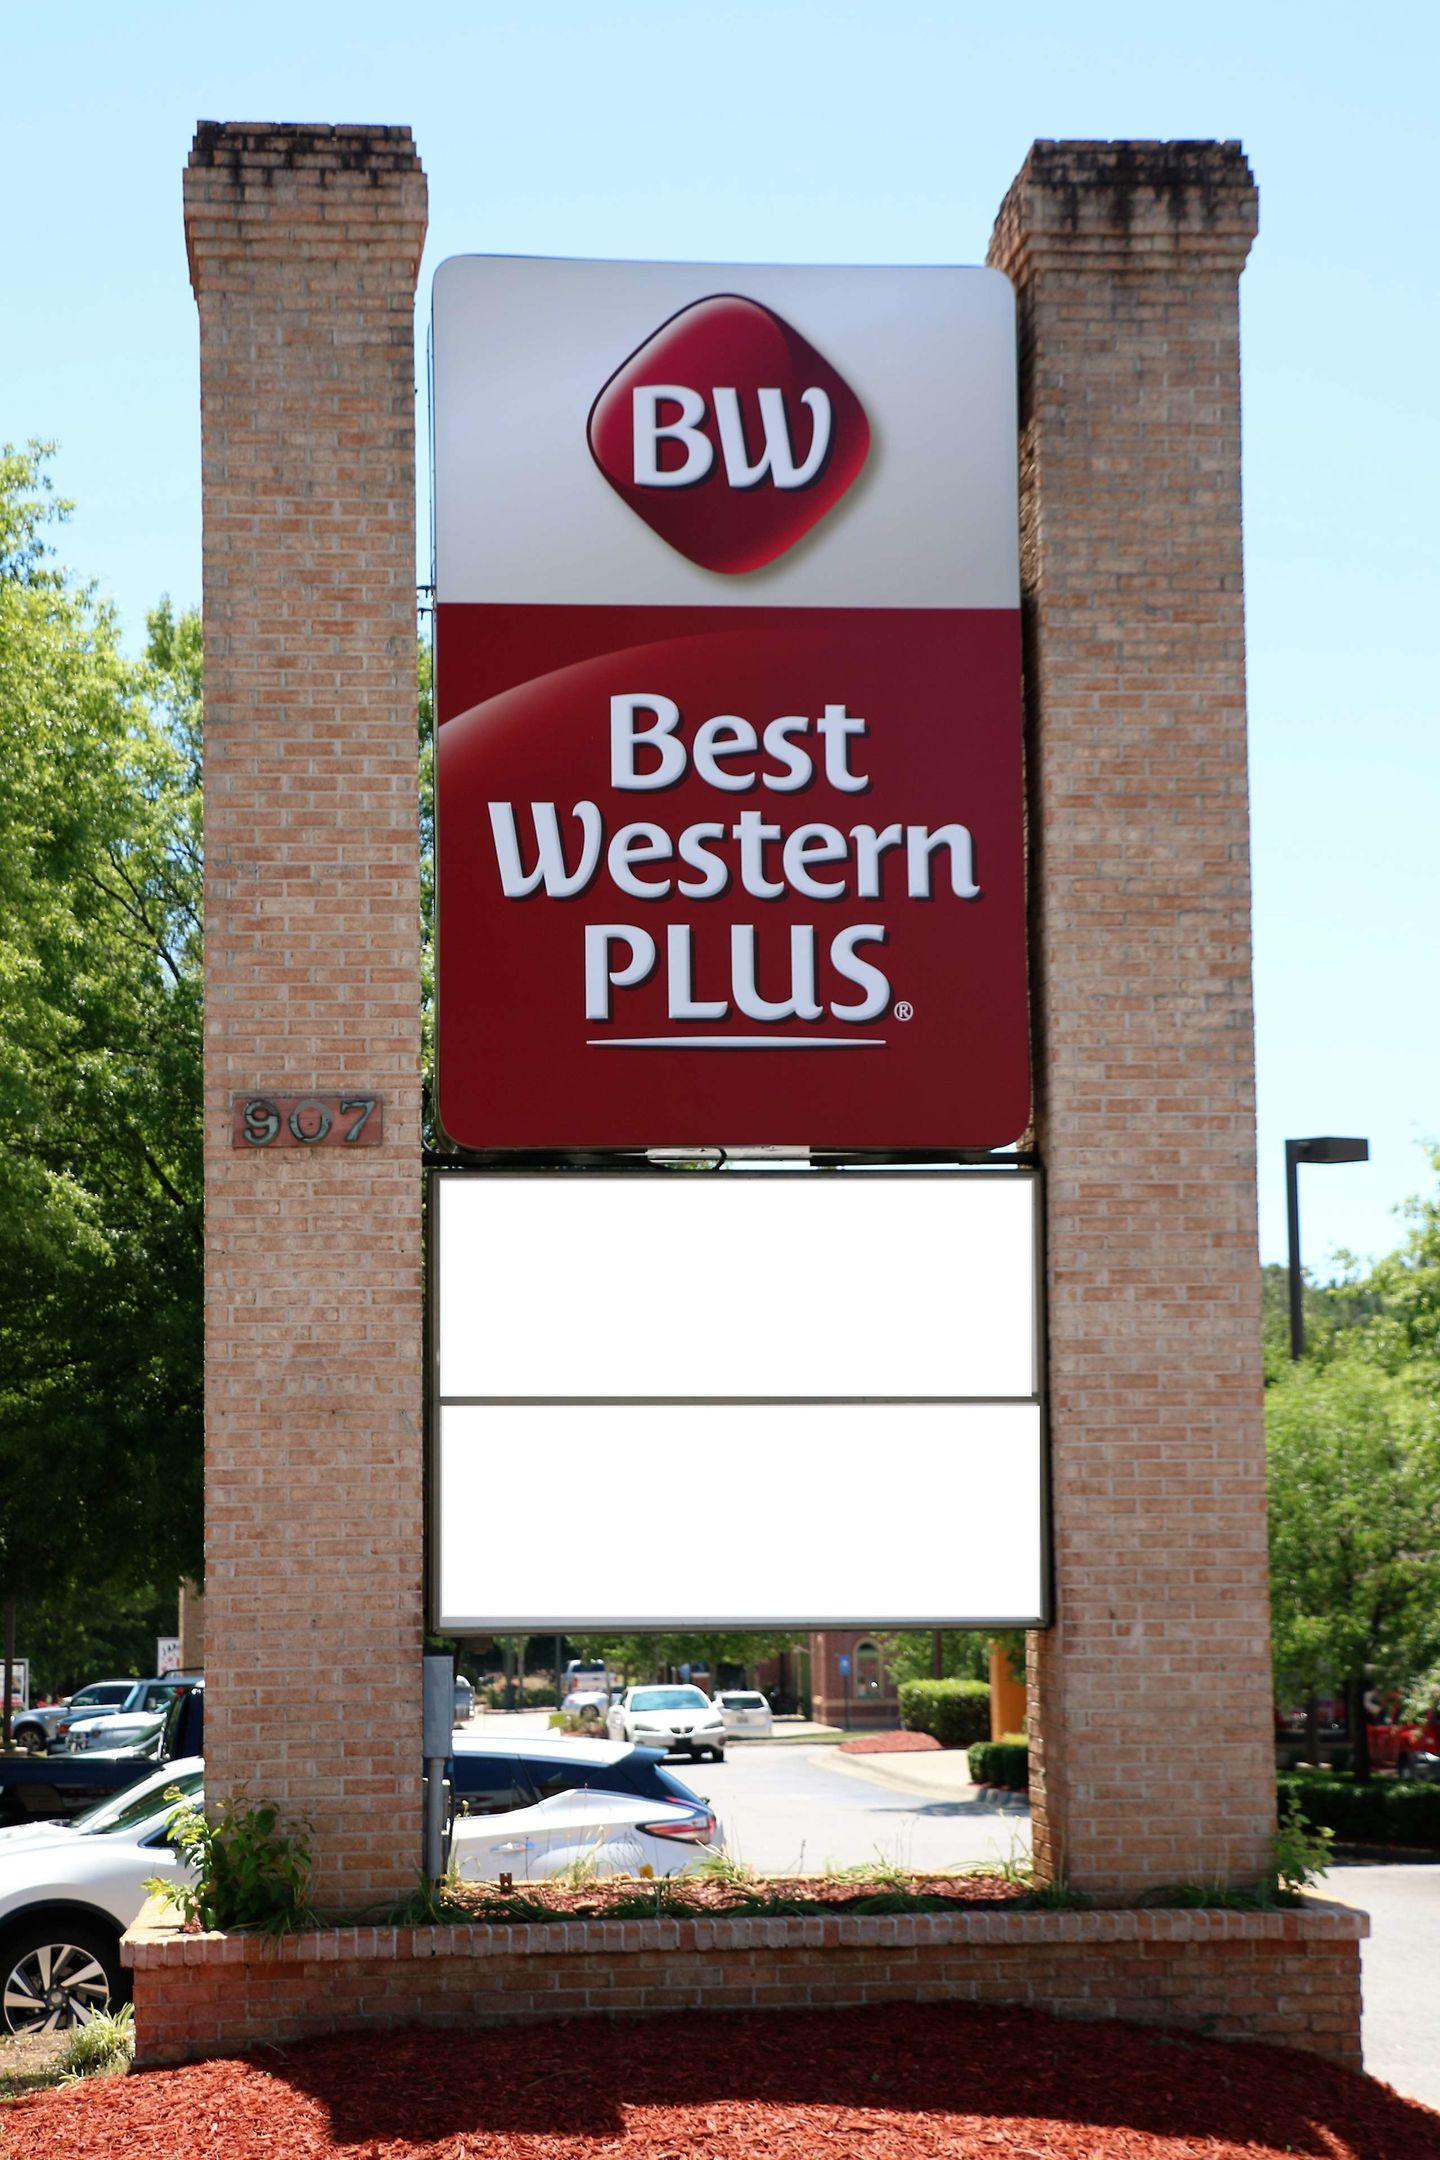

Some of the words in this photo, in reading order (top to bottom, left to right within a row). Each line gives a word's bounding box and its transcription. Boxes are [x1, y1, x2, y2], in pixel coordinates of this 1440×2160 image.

[632, 384, 831, 488] BW
[610, 693, 869, 792] Best
[487, 800, 981, 899] Western
[242, 1100, 376, 1146] 907
